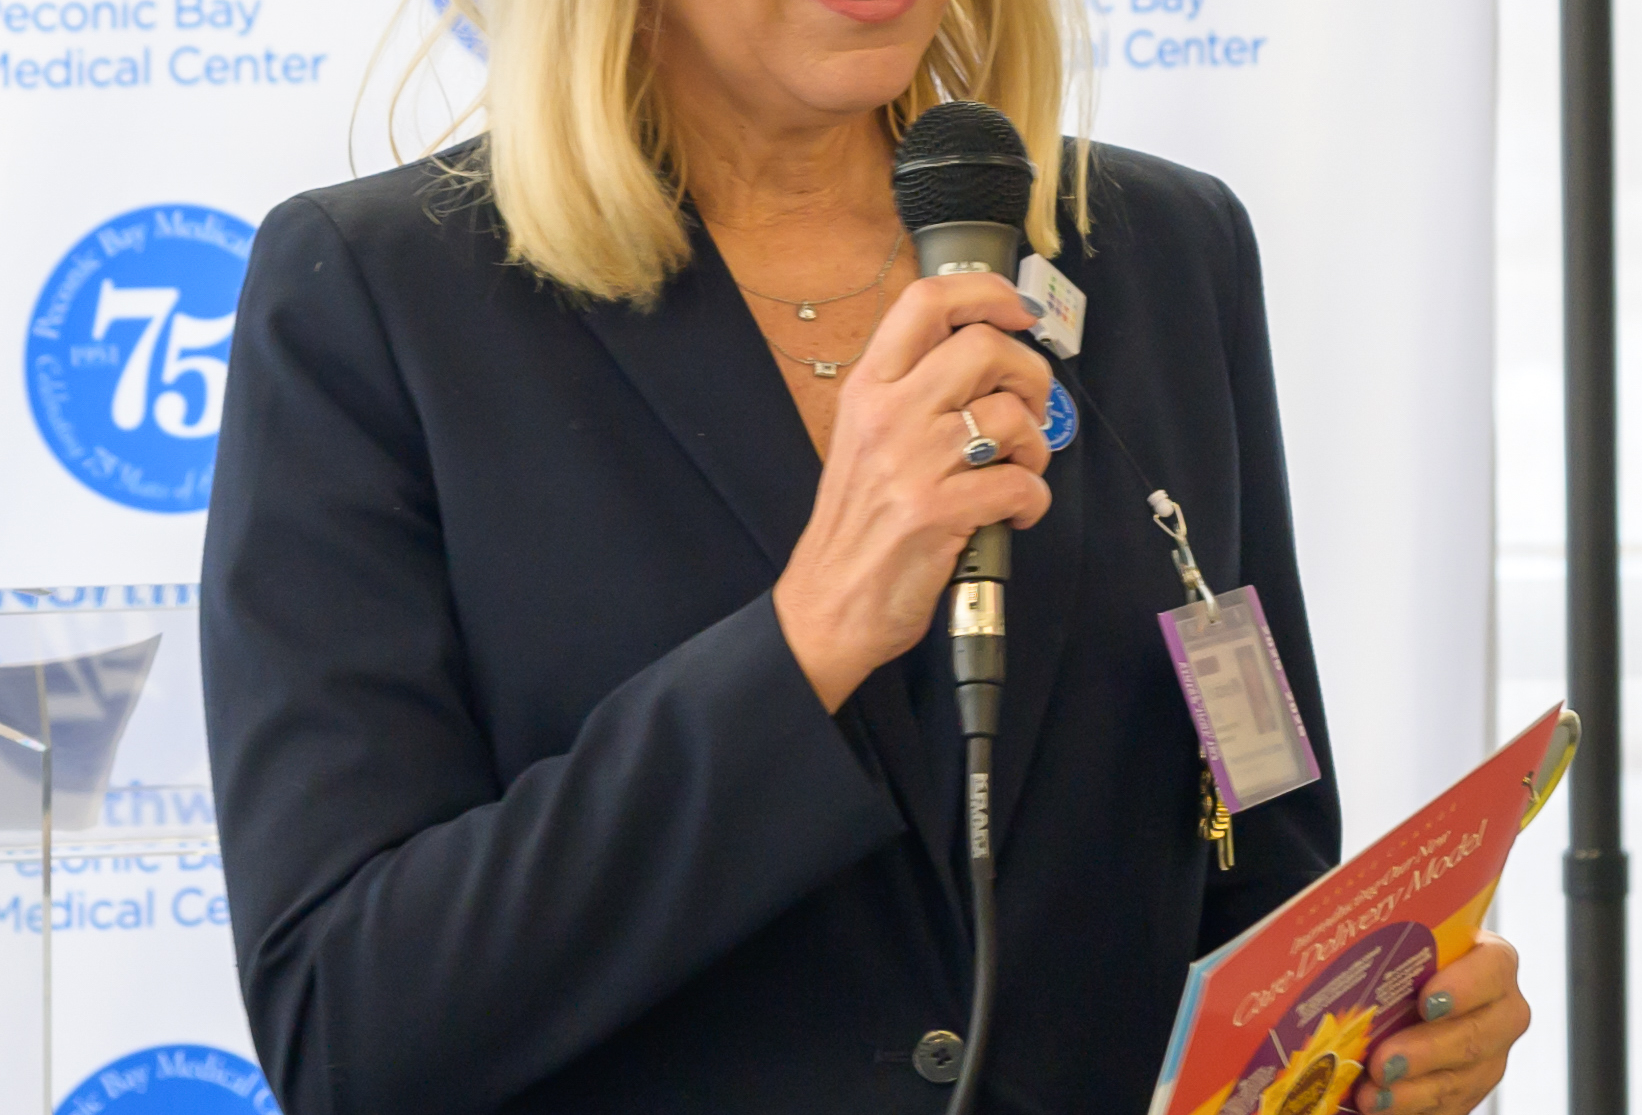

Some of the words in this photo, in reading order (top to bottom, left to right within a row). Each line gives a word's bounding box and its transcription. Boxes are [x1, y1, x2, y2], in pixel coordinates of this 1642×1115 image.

[0, 49, 150, 88] edical
[169, 46, 326, 86] Center
[1125, 30, 1264, 68] Center
[98, 225, 145, 256] Bay
[92, 278, 236, 438] 75
[1403, 818, 1488, 900] Model
